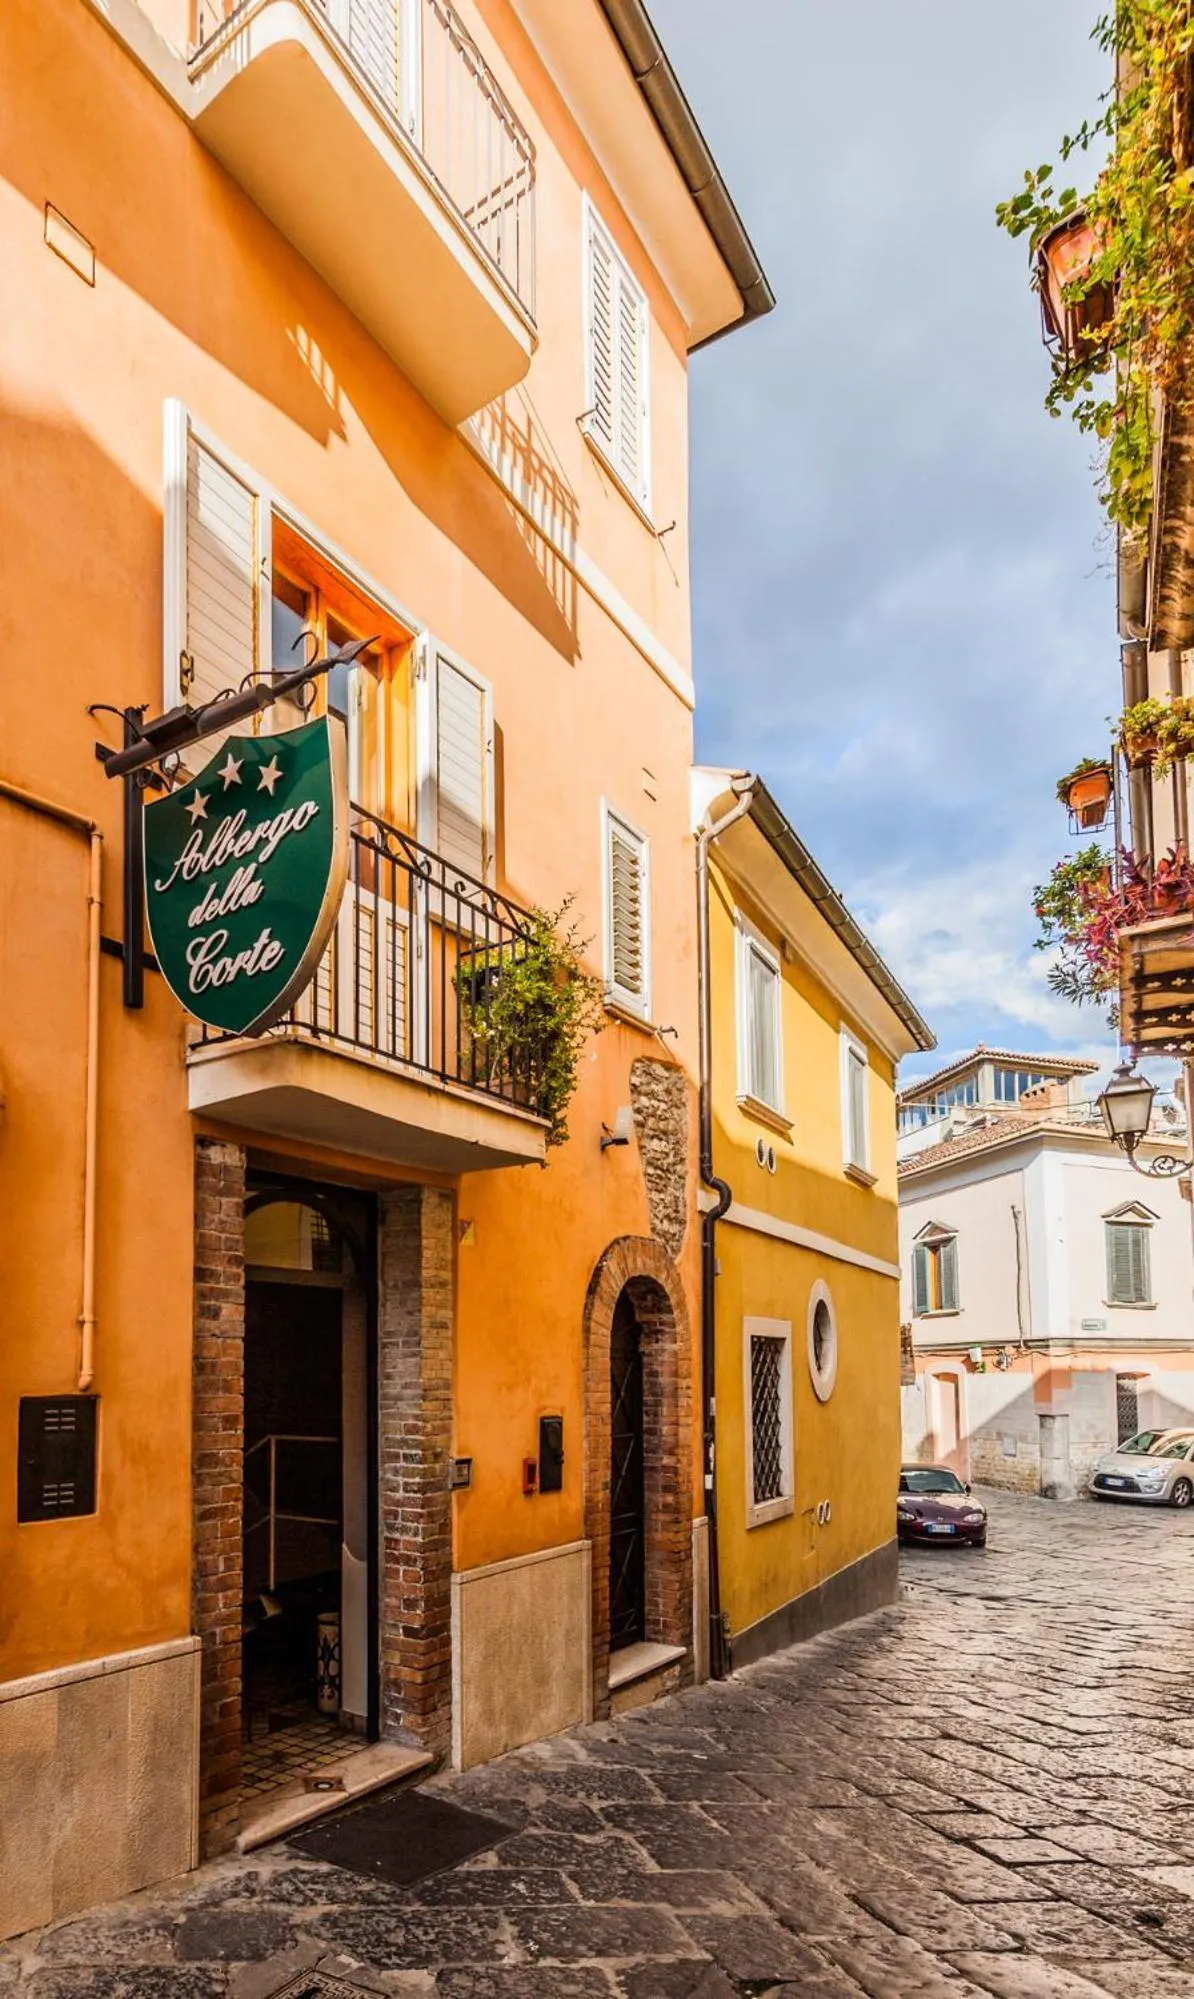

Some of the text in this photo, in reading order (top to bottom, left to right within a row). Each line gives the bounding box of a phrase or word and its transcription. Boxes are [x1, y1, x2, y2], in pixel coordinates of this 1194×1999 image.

[154, 799, 319, 892] Albergo
[188, 864, 265, 928] della
[185, 927, 285, 994] Corte
